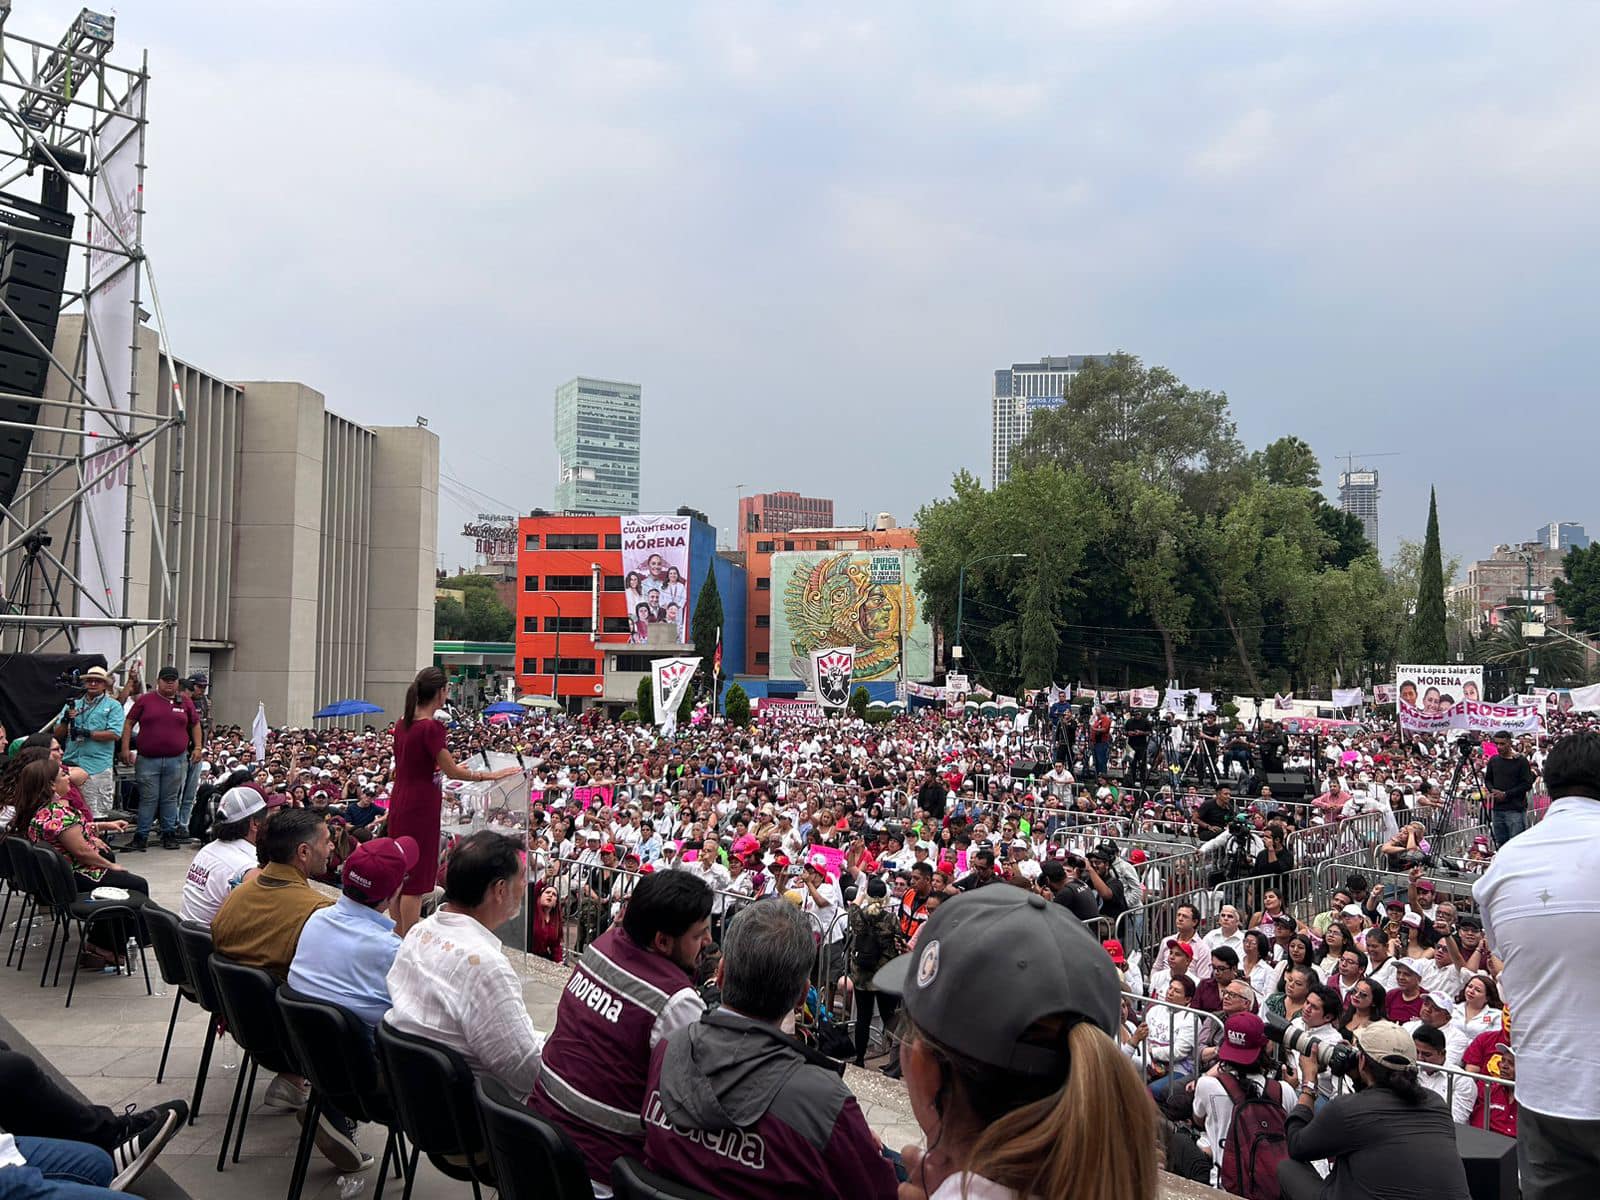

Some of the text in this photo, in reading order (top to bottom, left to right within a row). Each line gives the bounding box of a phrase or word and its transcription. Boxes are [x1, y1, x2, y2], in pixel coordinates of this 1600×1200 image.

[623, 523, 688, 534] CUAUHTÉMOC
[624, 536, 686, 550] MORENA
[1397, 666, 1421, 674] Teresa
[1417, 677, 1461, 685] MORENA
[566, 971, 624, 1023] morena
[1227, 1029, 1246, 1040] CATY
